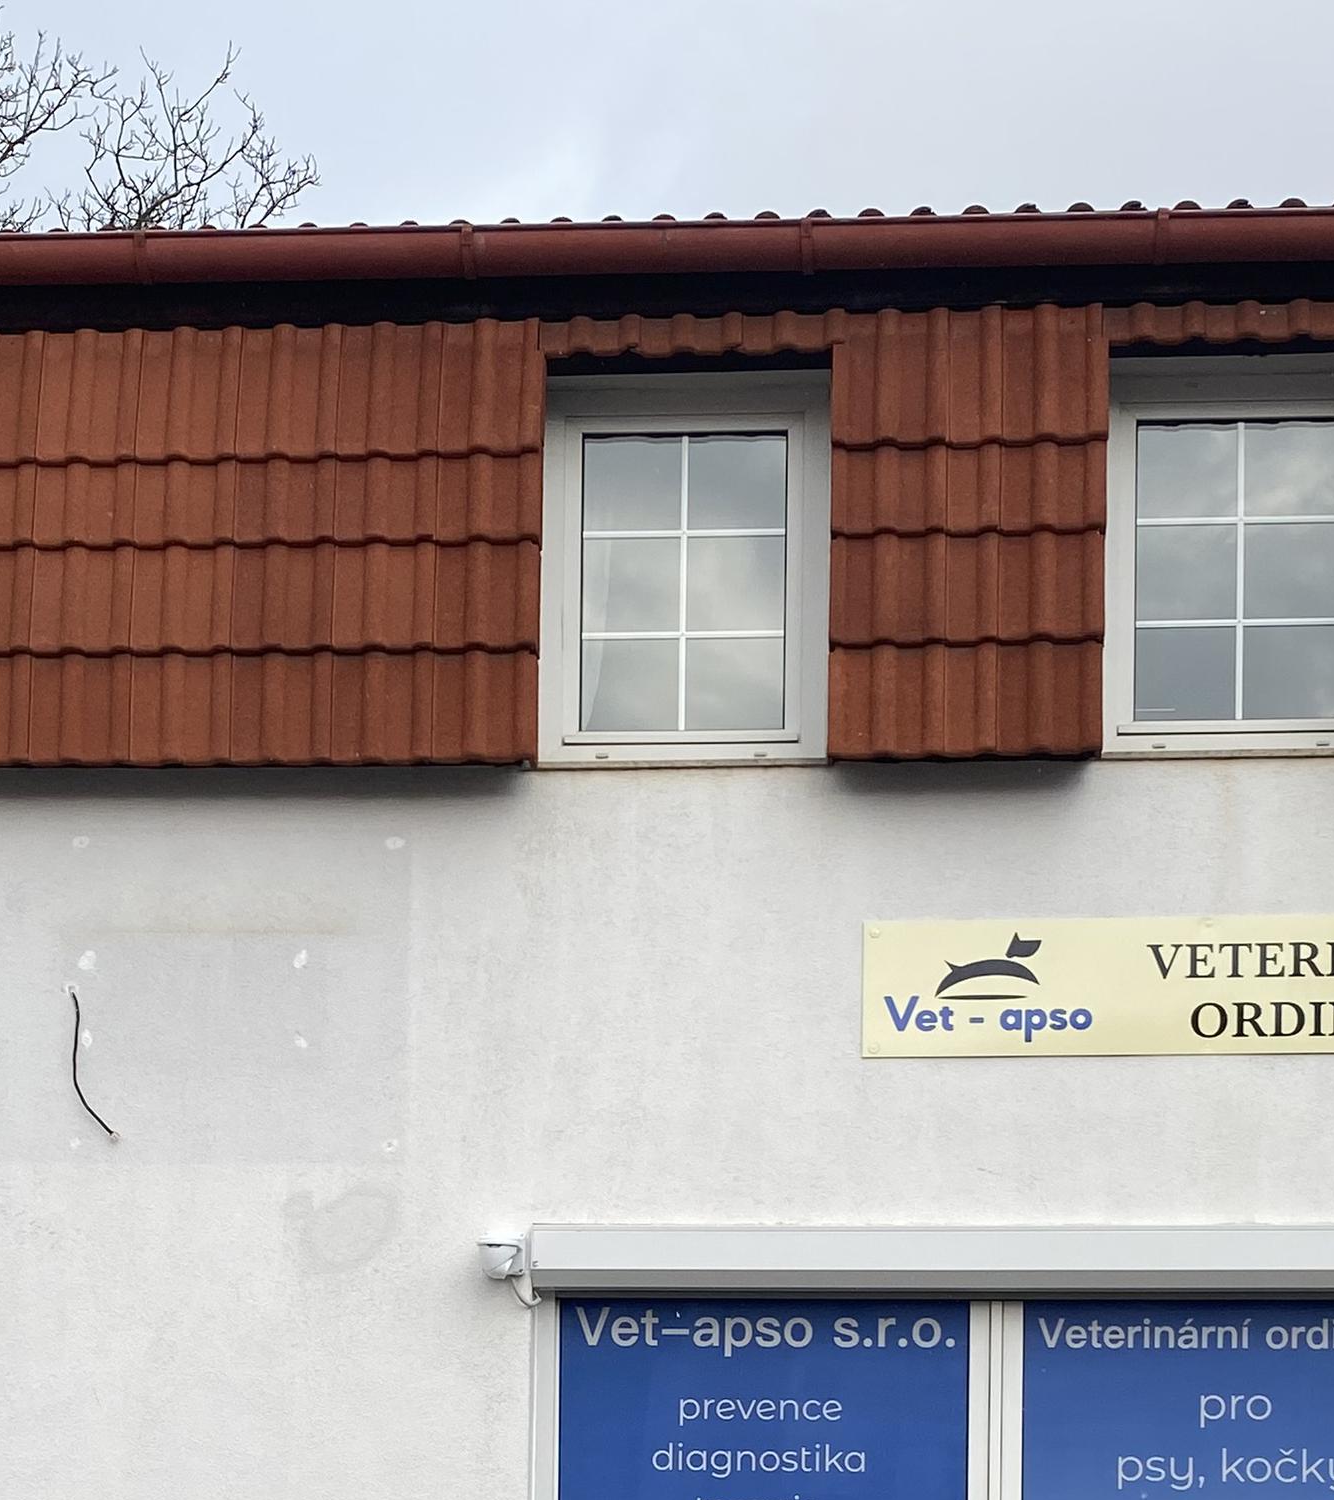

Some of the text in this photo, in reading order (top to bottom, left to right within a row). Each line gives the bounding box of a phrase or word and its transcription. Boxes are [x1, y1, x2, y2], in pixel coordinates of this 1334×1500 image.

[883, 995, 954, 1032] Vet
[999, 1006, 1093, 1043] apso
[833, 1316, 957, 1348] s.r.o.
[1038, 1317, 1252, 1350] Veterinární
[678, 1397, 843, 1427] prevence
[1199, 1393, 1273, 1428] pro
[651, 1442, 867, 1478] diagnostika
[1117, 1454, 1207, 1491] psy,
